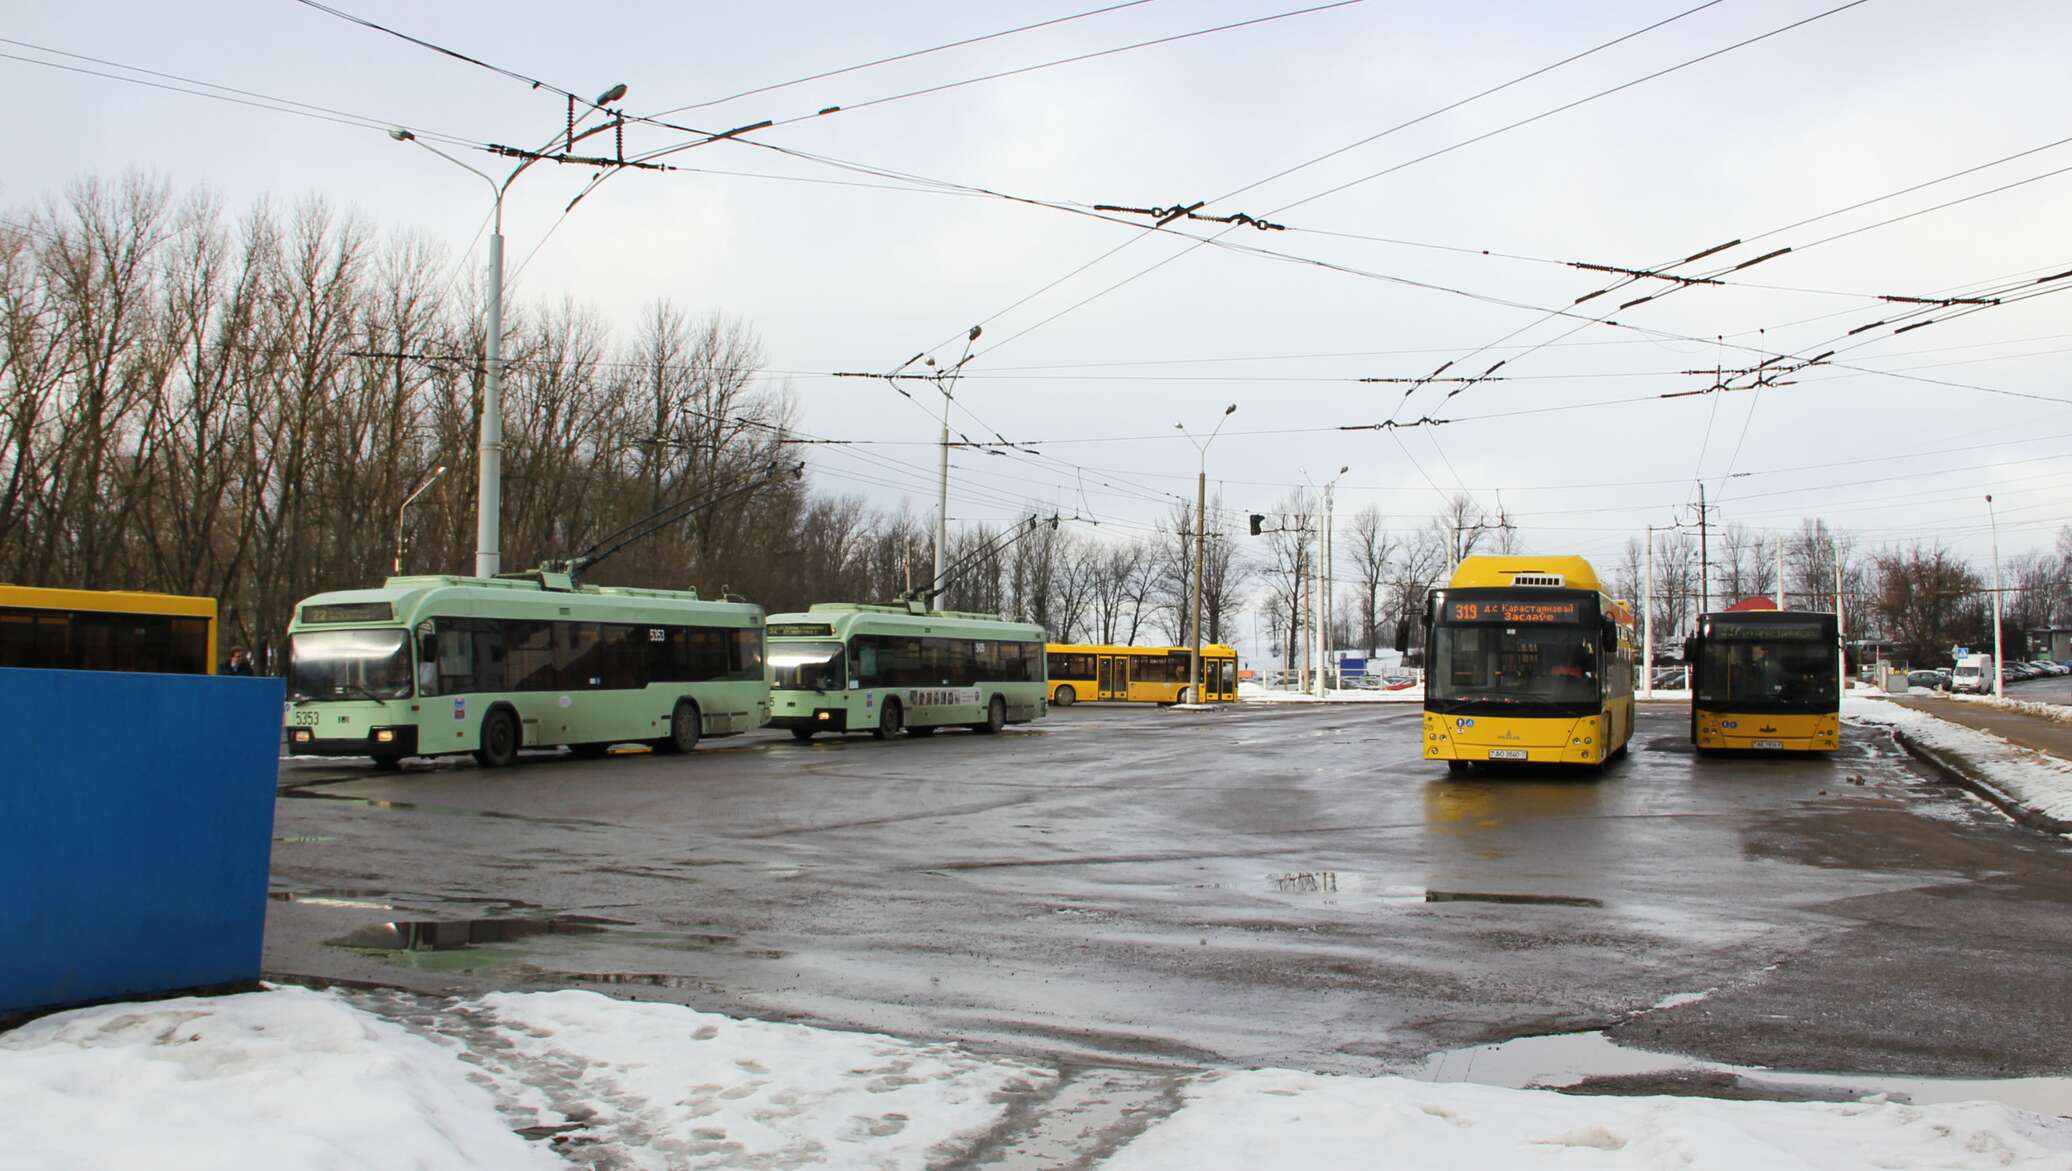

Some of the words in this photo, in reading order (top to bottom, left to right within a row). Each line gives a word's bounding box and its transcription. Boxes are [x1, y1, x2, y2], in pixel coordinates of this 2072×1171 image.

[1456, 604, 1478, 620] 319
[650, 629, 665, 641] 5353
[296, 711, 319, 725] 5353
